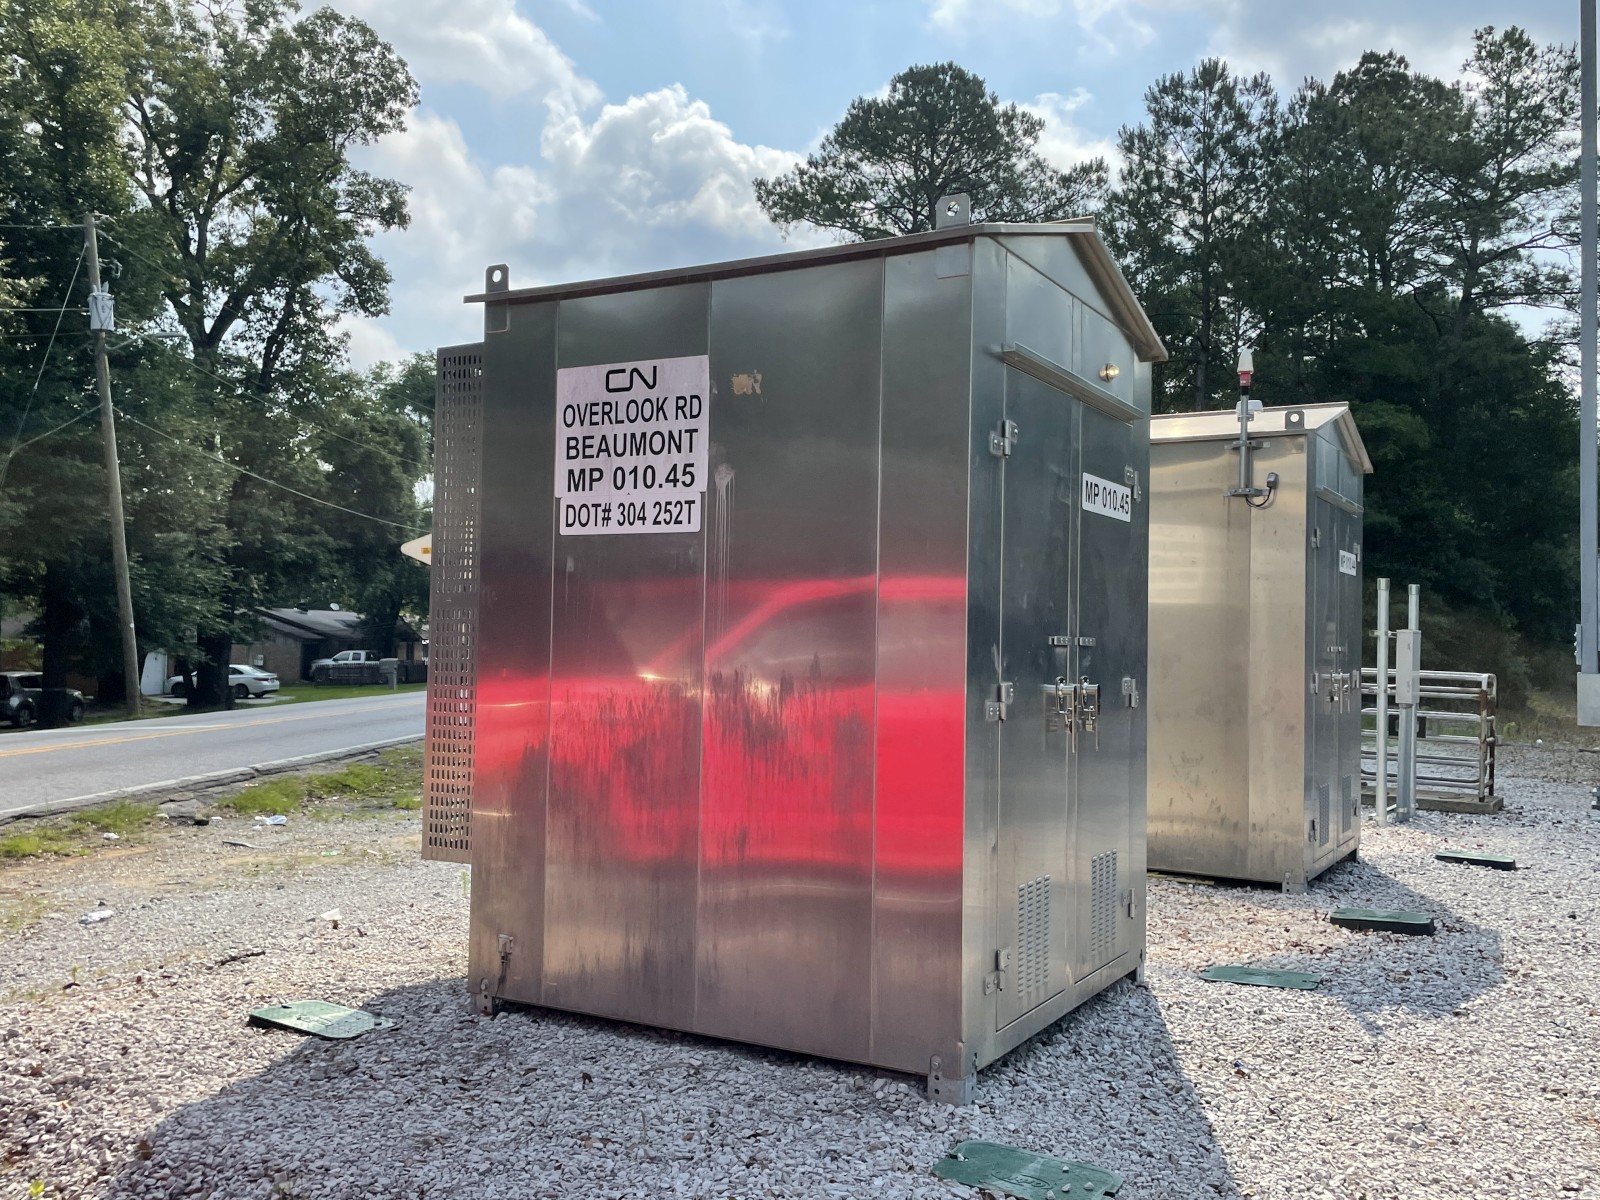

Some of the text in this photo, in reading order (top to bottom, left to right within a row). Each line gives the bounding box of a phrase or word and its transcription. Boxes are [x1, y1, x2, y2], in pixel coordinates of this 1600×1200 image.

[605, 365, 658, 393] CN
[563, 394, 702, 428] OVERLOOK RD
[566, 428, 699, 460] BEAUMONT
[567, 463, 696, 493] MP 010.45
[1085, 480, 1130, 515] MP 010.45
[565, 500, 696, 528] DOT# 304 252T
